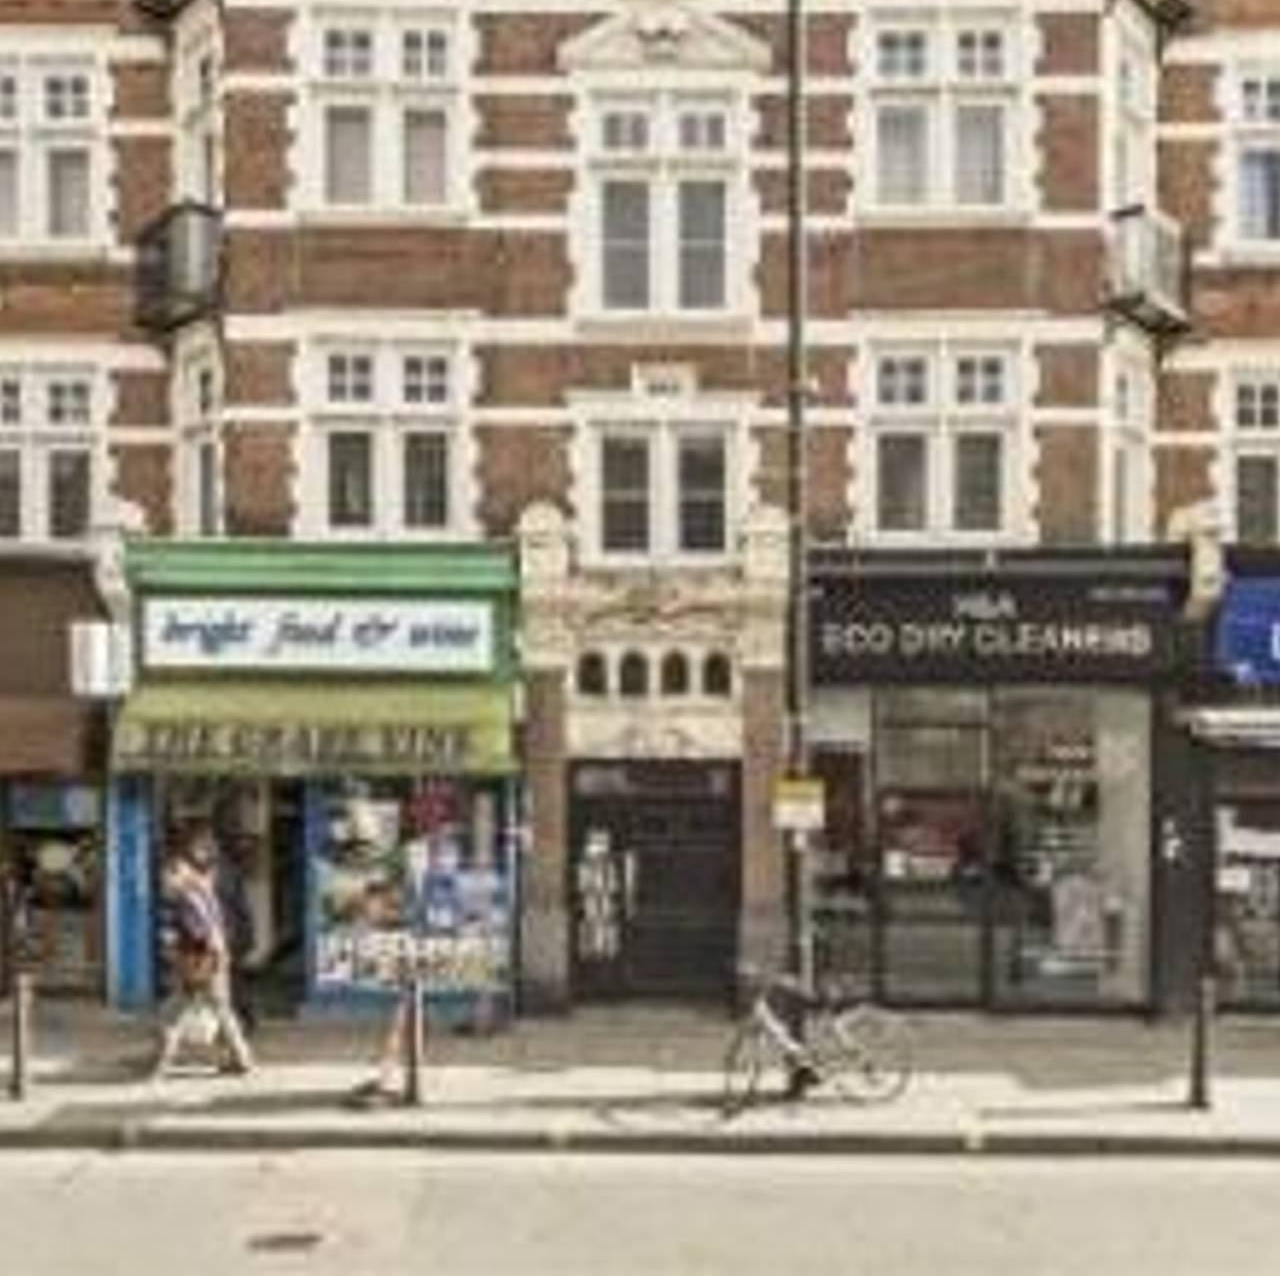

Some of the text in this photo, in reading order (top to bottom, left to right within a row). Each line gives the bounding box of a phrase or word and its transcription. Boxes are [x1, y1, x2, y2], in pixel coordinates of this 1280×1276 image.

[265, 612, 342, 656] food
[822, 622, 1154, 656] ECO DRY CLEANERS
